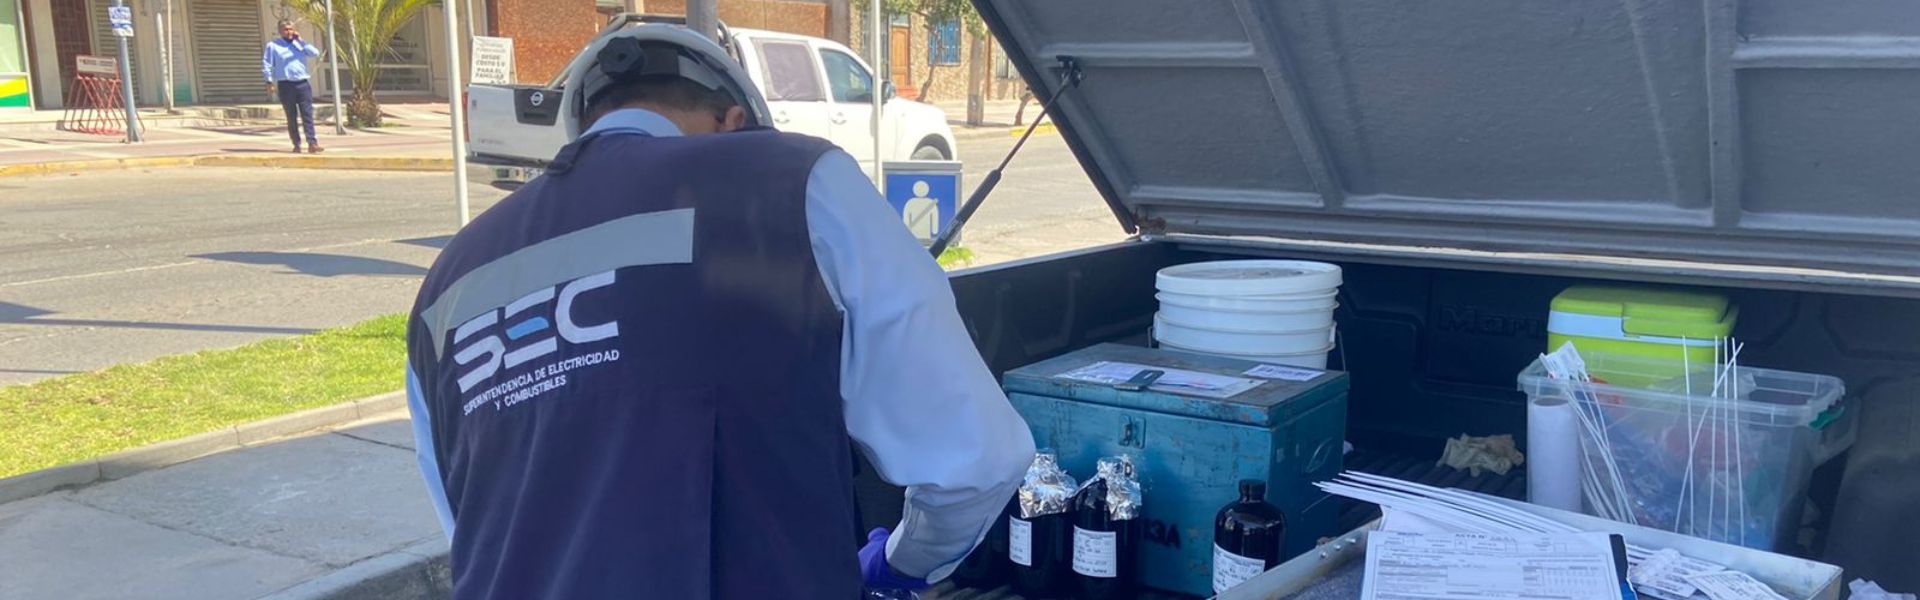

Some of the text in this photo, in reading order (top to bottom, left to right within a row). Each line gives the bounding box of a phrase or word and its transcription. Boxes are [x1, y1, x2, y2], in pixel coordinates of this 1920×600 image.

[453, 270, 619, 394] SEC
[463, 349, 620, 416] SUPERINTENDENCIA DE ELECTRICIDAD
[493, 375, 567, 411] Y COMBUSTIBLES
